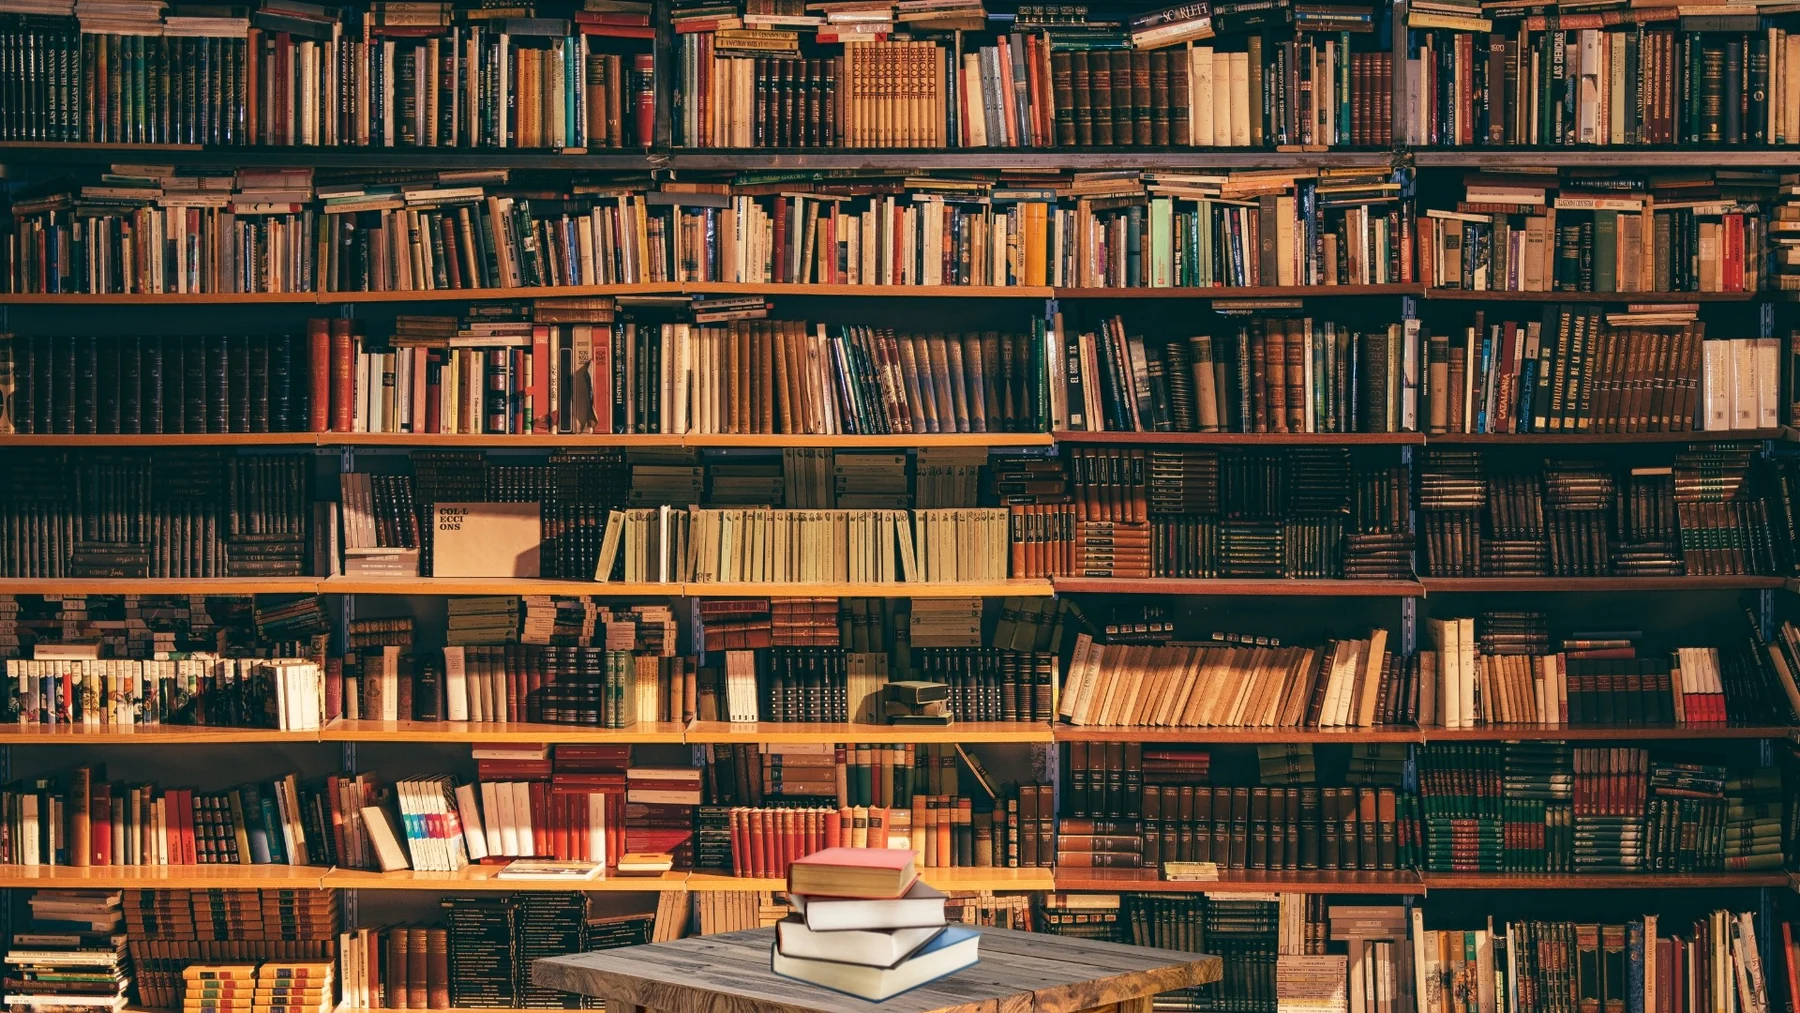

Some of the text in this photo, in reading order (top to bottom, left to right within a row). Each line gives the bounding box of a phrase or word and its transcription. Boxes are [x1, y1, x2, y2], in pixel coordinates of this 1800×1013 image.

[1162, 2, 1208, 23] SCRLETT
[1553, 32, 1564, 79] LAS CIENCIAS
[1586, 315, 1599, 354] OCCIDENTAL
[1552, 359, 1566, 410] CIVILIZACIONES
[1570, 367, 1579, 376] DE
